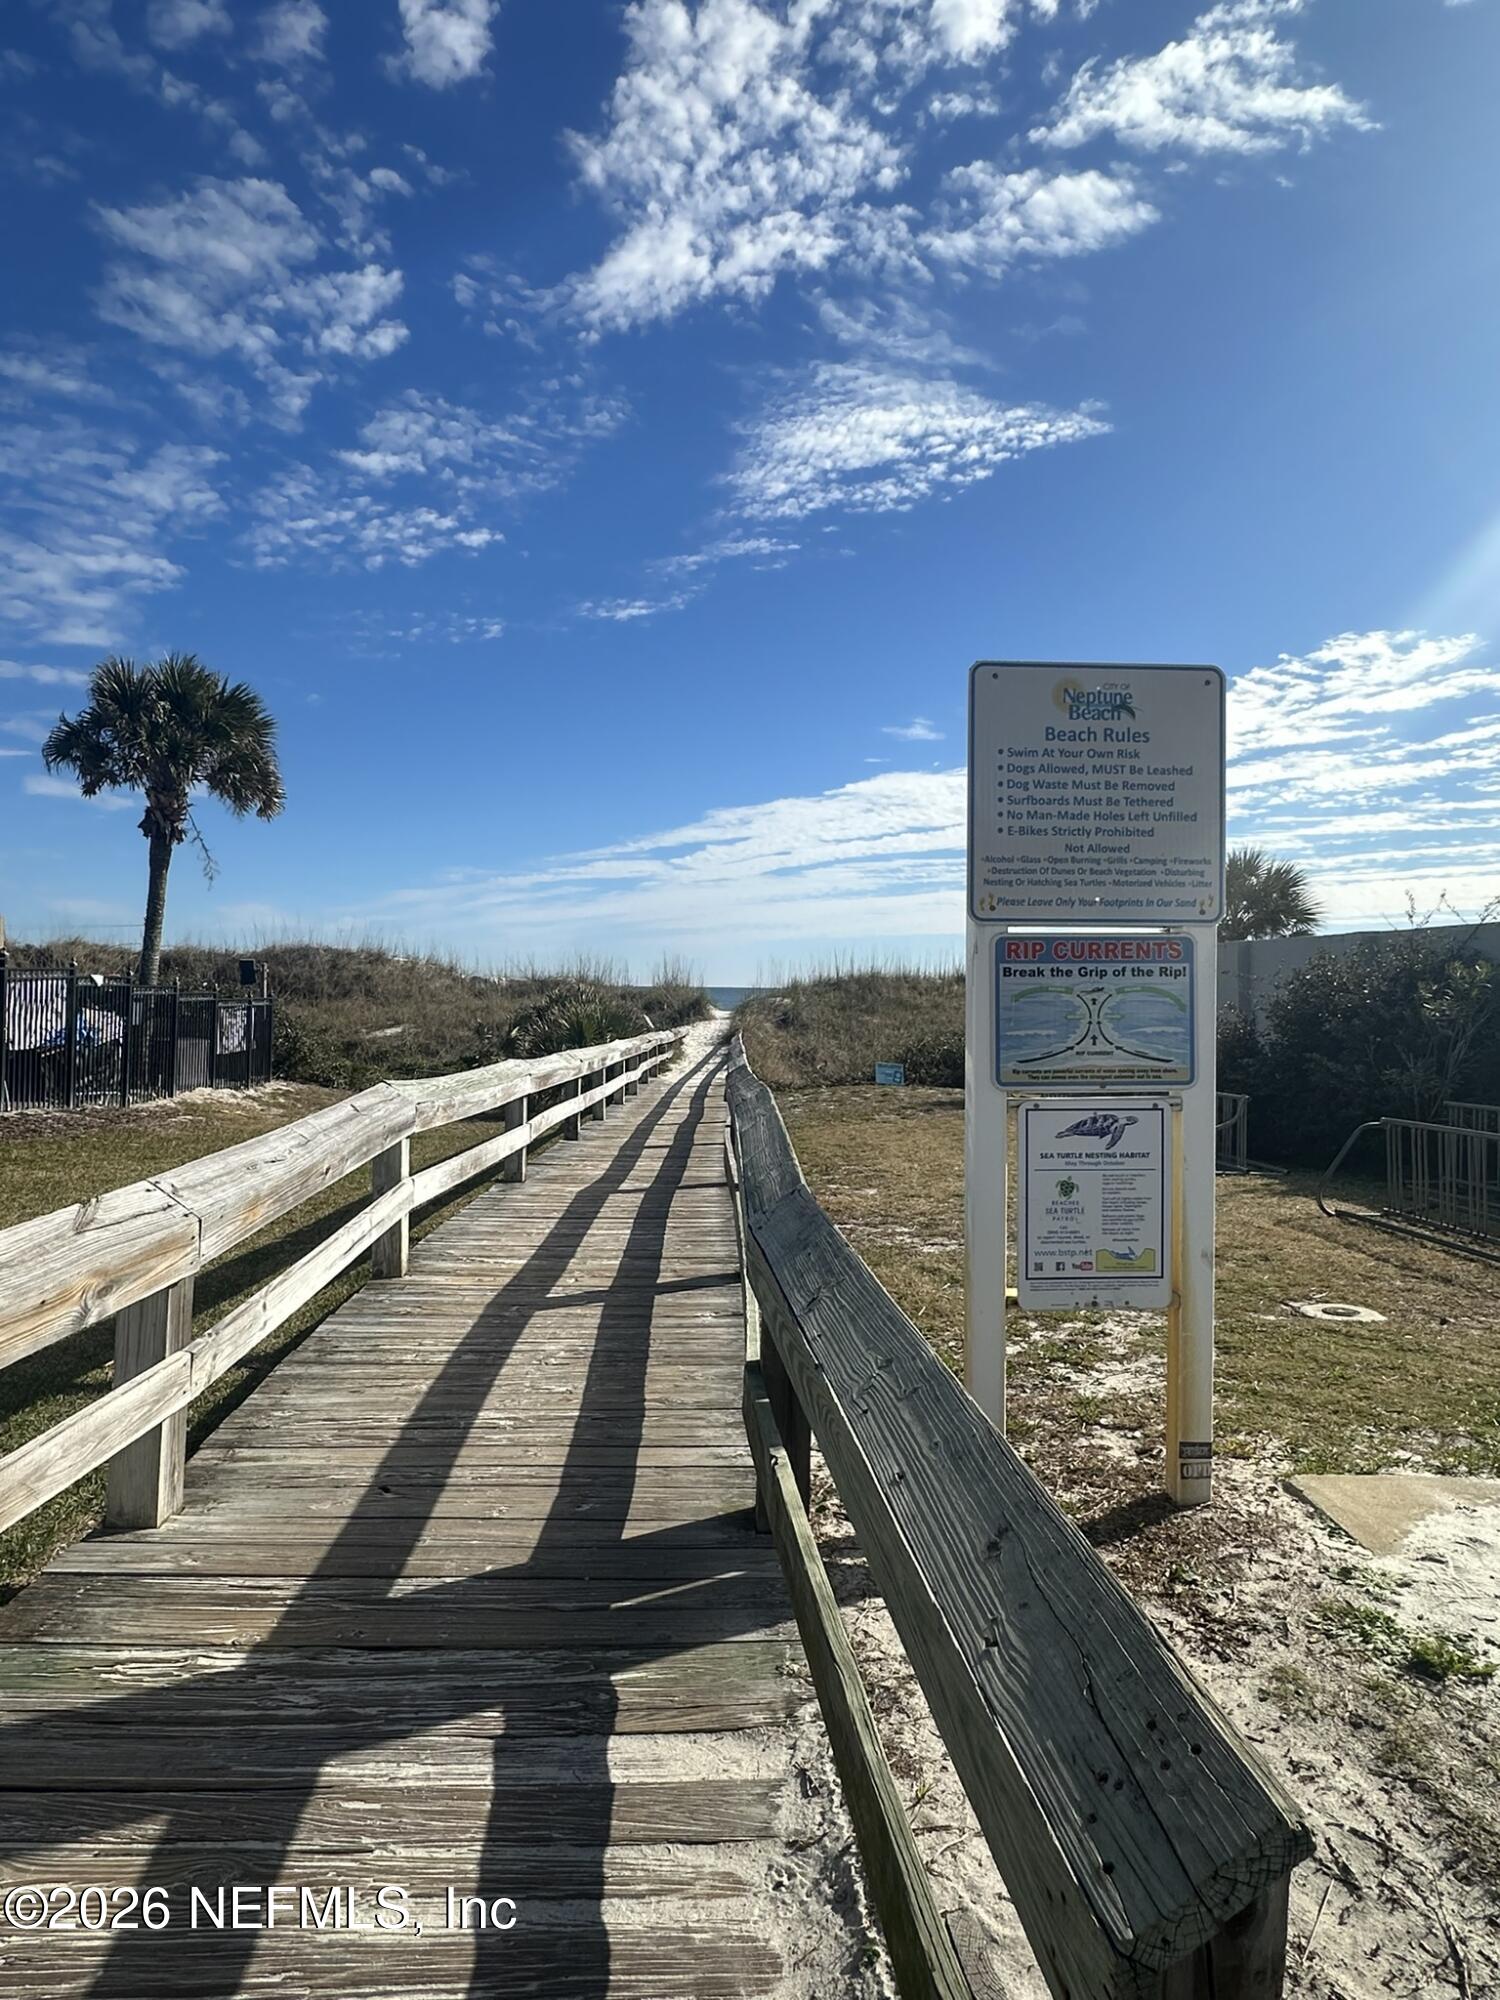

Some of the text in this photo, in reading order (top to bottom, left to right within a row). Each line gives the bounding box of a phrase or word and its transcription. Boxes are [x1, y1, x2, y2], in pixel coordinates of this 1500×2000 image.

[1063, 688, 1132, 707] Neptune
[1069, 704, 1121, 720] Beach
[1045, 727, 1150, 743] Beach Rules
[1007, 747, 1140, 759] Swim At Your Own Risk
[1007, 764, 1193, 776] Dogs Allowed, MUST Be Leashed
[1007, 780, 1175, 792] Dog Waste Must Be Removed
[1007, 796, 1173, 807] Surfboards Must Be Tethered
[1007, 811, 1197, 822] No Man-Made Holes Left Unfilled
[1007, 826, 1154, 839] E-Bikes Strictly Prohibited
[1065, 843, 1130, 853] Not Allowed
[997, 897, 1196, 908] Please Leave Only Your Footprints In Our Sand
[1006, 940, 1182, 960] RIP CURRENTS
[1003, 967, 1186, 979] Break the Grip of the Rip!
[1034, 1248, 1093, 1258] www.bstp.net
